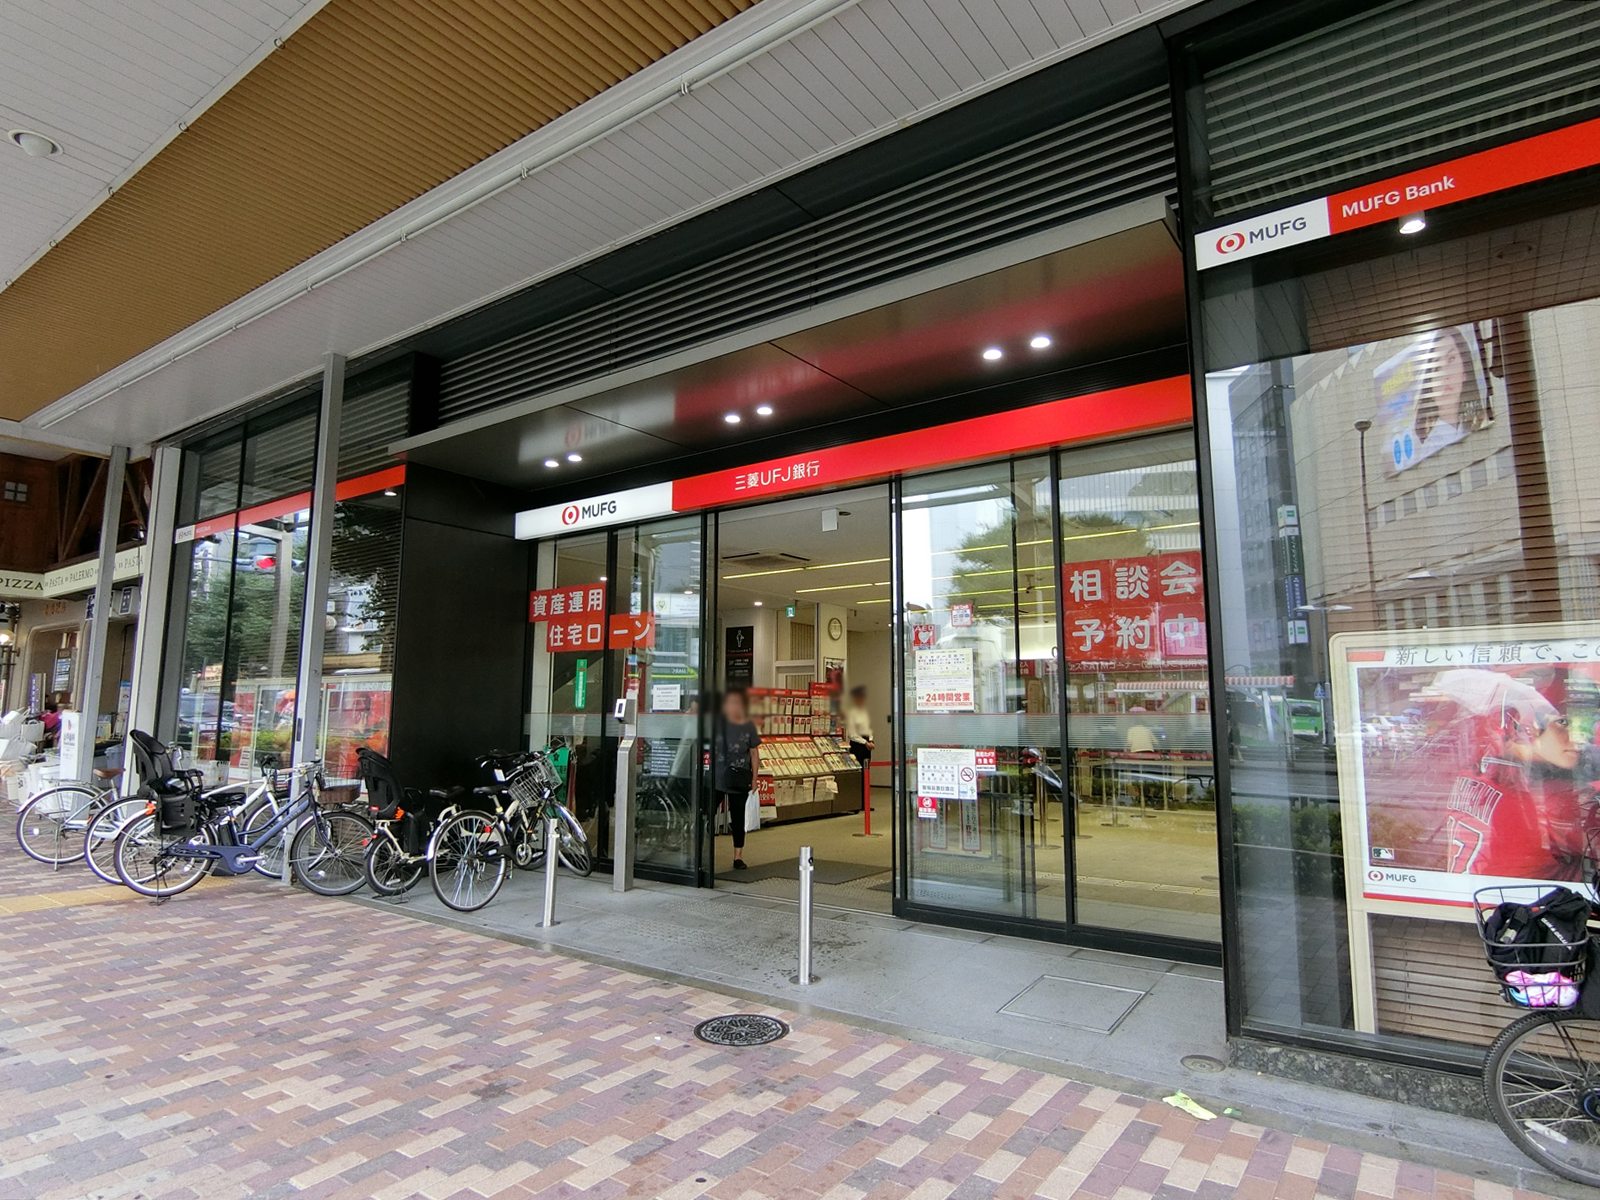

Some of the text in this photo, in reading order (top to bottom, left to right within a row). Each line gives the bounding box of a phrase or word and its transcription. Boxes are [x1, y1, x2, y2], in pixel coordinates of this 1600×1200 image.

[1341, 176, 1455, 218] MUFG Bank
[1249, 217, 1307, 244] MUFG
[735, 461, 820, 491] 三菱UFJ銀行
[582, 500, 617, 519] MUFG
[1069, 560, 1197, 602] 相談会
[533, 588, 603, 617] 資産運用
[549, 620, 650, 647] 住宅ローン
[1072, 613, 1199, 652] 予約中
[1396, 642, 1600, 665] 新しい信頼で、こ
[1385, 873, 1417, 883] MUFG
